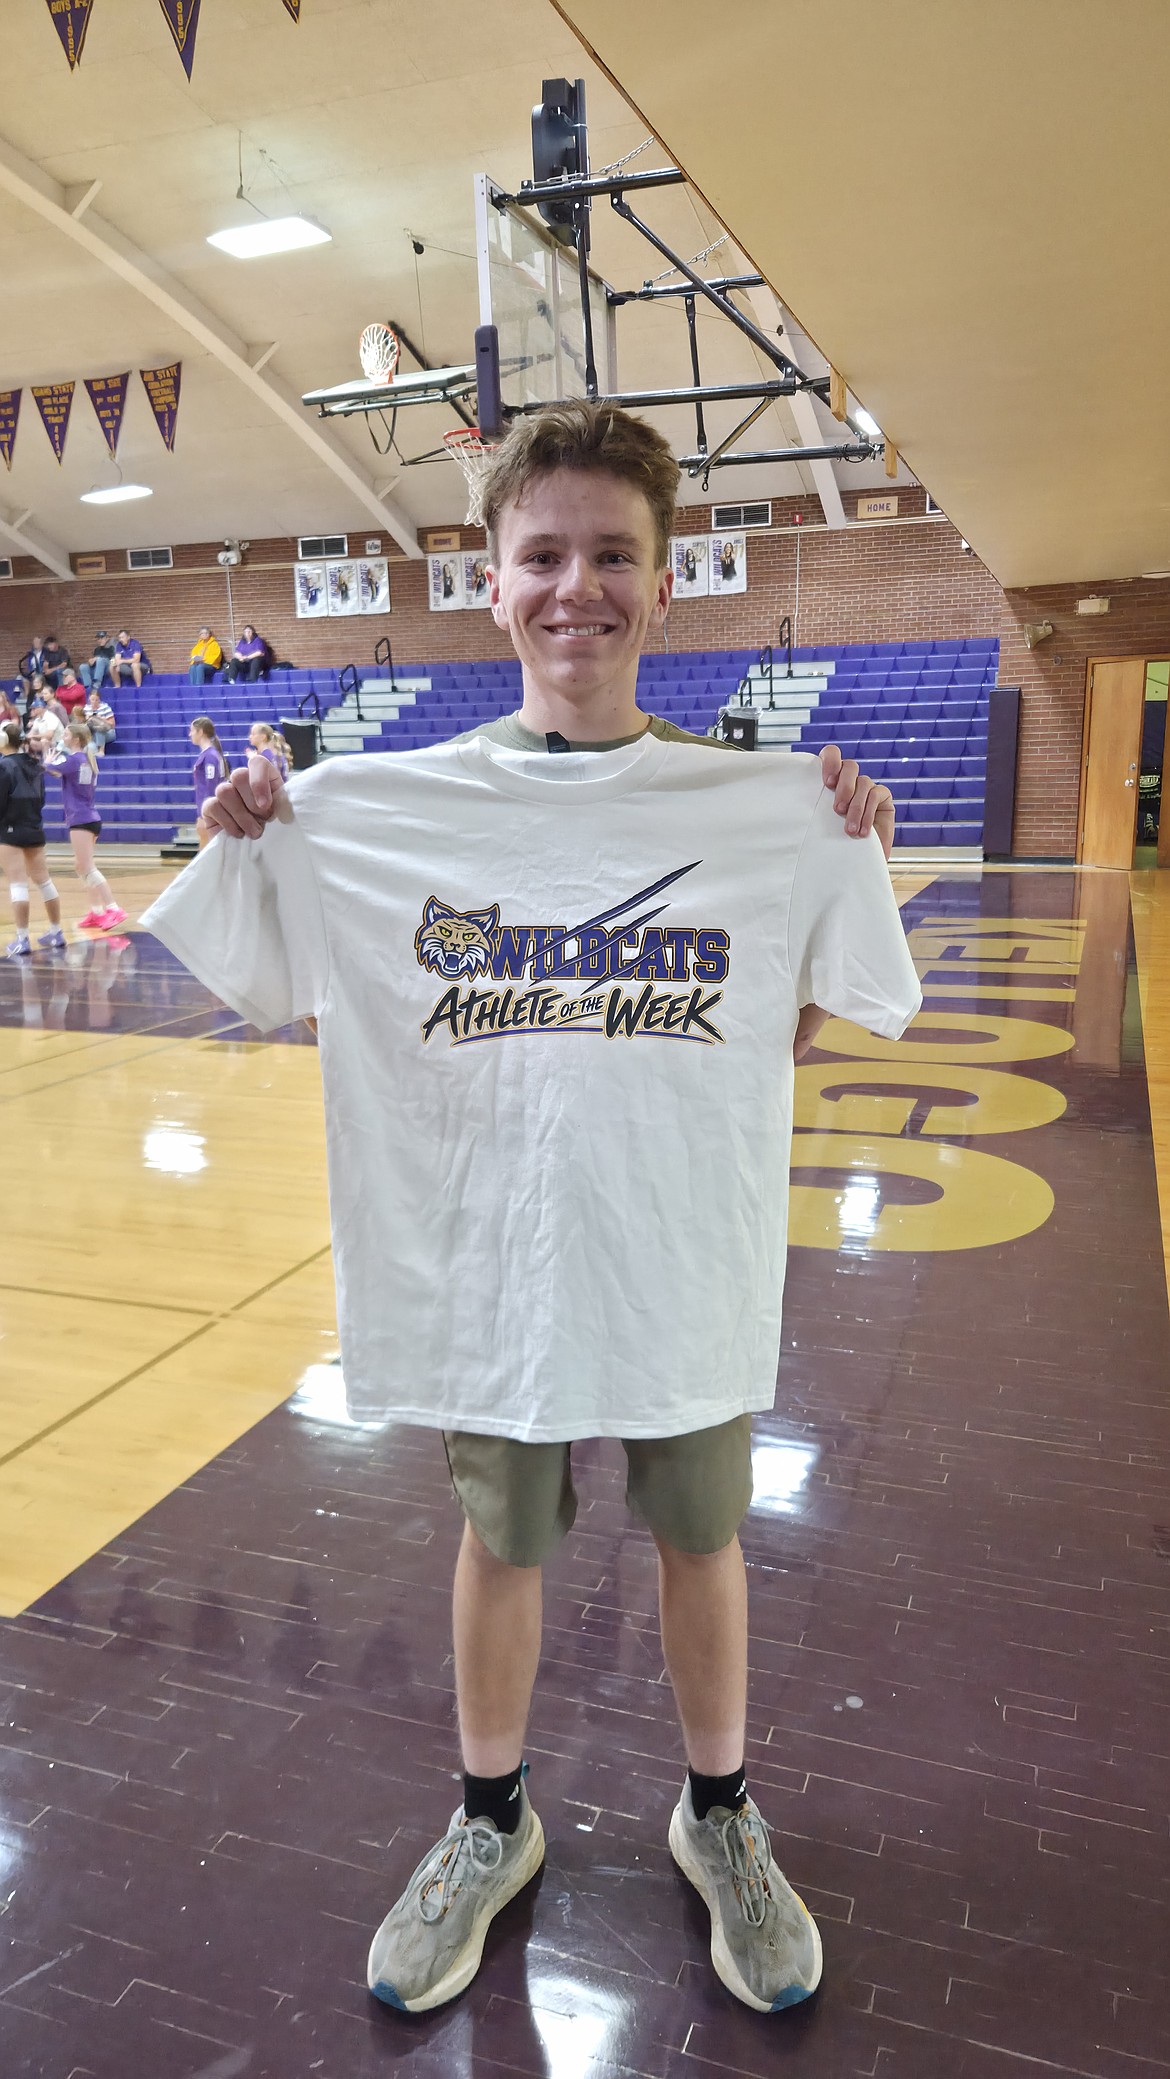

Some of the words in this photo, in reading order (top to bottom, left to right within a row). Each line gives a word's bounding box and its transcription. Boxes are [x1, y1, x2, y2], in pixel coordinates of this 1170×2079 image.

[867, 503, 891, 512] HOME
[712, 539, 723, 576] WILDCATS
[493, 926, 730, 983] WILDCATS
[422, 986, 565, 1042] ATHLETE
[560, 1001, 579, 1018] OF
[580, 995, 605, 1013] THE
[605, 983, 726, 1044] WEEK
